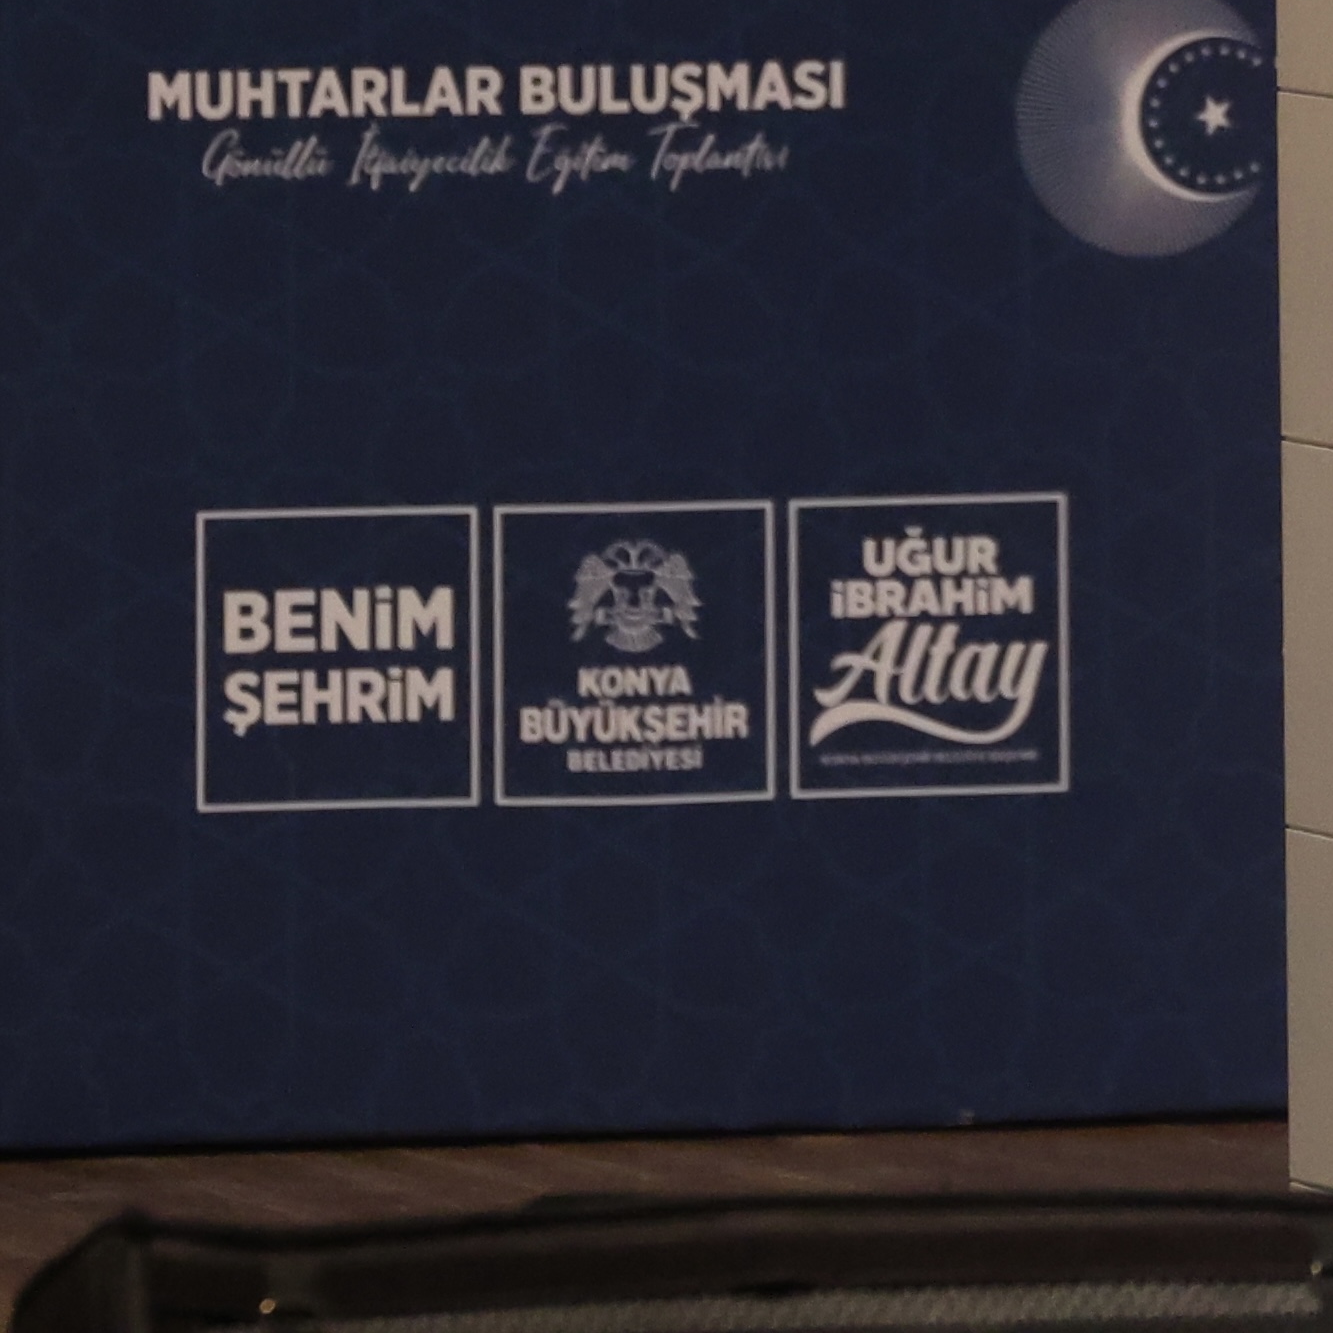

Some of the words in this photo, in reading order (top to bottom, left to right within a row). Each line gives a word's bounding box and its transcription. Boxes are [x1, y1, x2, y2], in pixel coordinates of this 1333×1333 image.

[148, 66, 503, 120] MUHTARLAR
[519, 59, 845, 123] BULUŞMASI
[863, 526, 1000, 579] UĞUR
[579, 666, 691, 697] KONYA
[810, 617, 1048, 745] Altay
